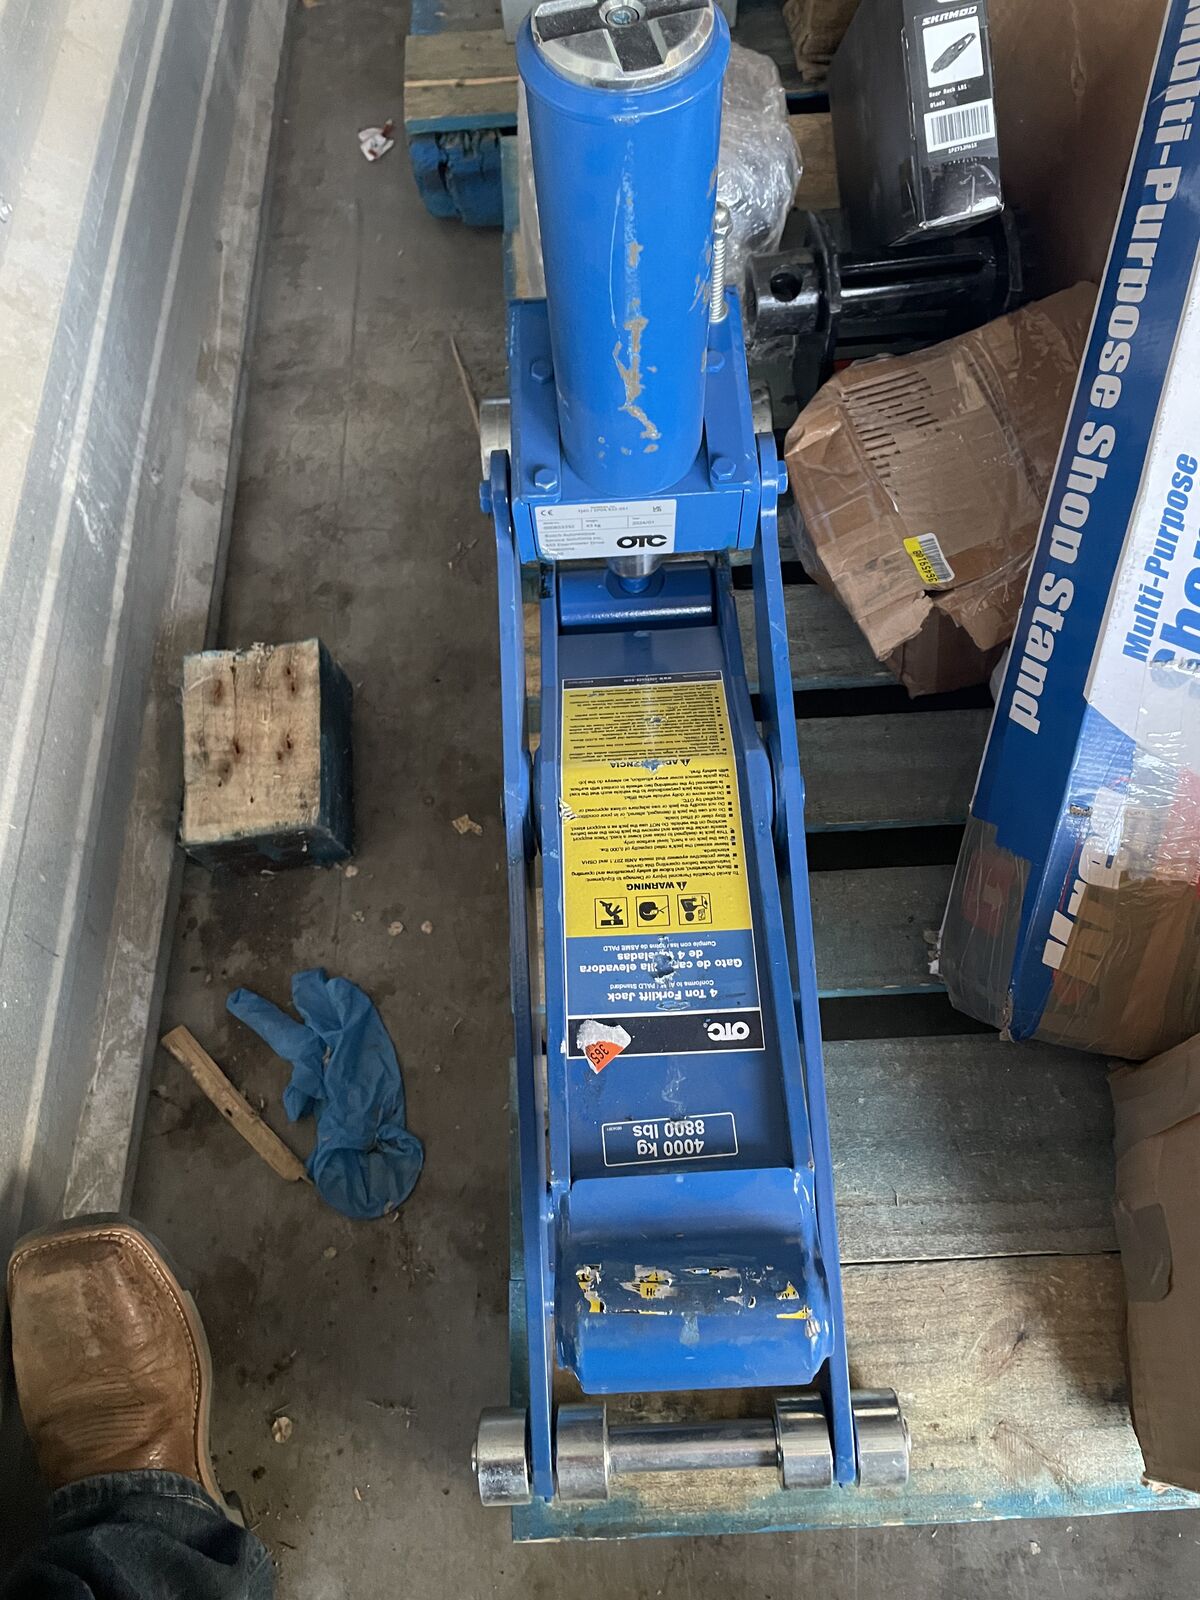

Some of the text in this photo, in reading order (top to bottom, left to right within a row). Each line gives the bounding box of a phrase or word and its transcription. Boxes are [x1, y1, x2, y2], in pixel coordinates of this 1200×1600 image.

[1049, 421, 1116, 564] Shop
[617, 535, 667, 548] OTC
[1122, 452, 1198, 662] Multi-Purpose
[1008, 572, 1074, 734] Stand
[626, 882, 674, 890] WARNING
[678, 951, 685, 959] 4
[689, 950, 703, 958] de
[580, 963, 636, 973] elevadora
[697, 960, 710, 969] de
[715, 958, 742, 968] Gato
[608, 989, 718, 1002] 4 Ton Forklift Jack
[707, 1021, 750, 1041] OTC
[590, 1044, 609, 1064] 365
[632, 1120, 704, 1139] 8800 lbs
[637, 1138, 704, 1157] 4000 kg
